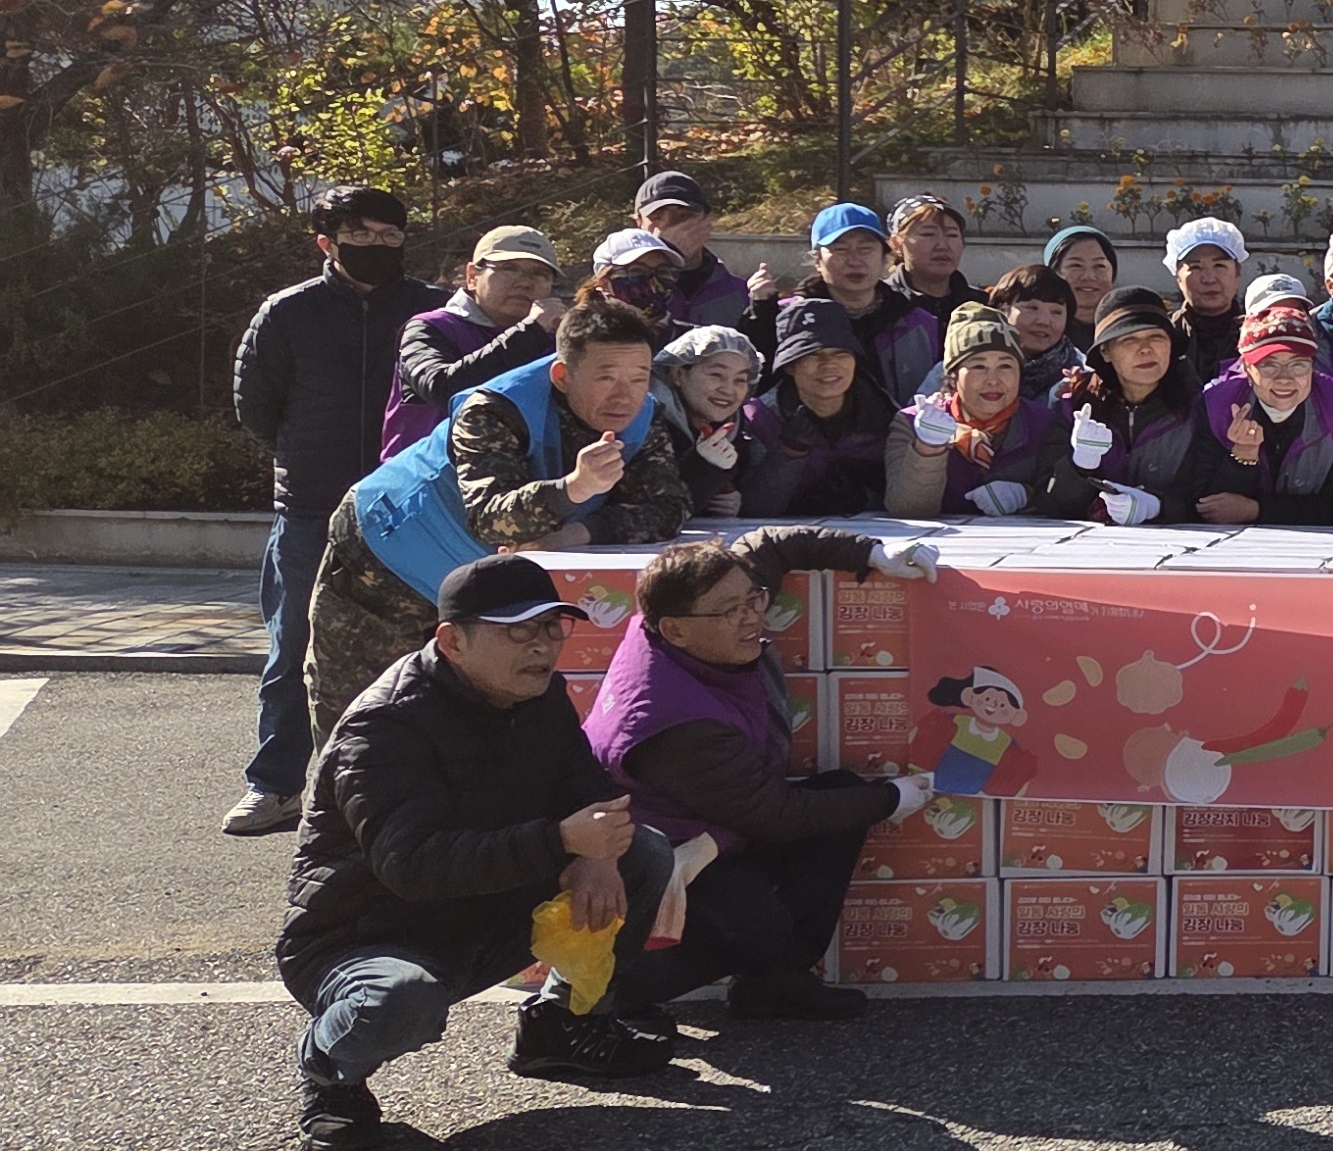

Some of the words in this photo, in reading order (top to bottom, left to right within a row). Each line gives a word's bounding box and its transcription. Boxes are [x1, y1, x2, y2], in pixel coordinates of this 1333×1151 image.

[838, 606, 869, 621] 김장
[872, 606, 904, 620] 나눔
[845, 717, 876, 732] 김장
[1012, 809, 1042, 824] 김장
[1045, 810, 1076, 826] 나눔
[1183, 812, 1239, 827] 김장김치
[1242, 813, 1270, 827] 나눔
[844, 922, 874, 938] 김장
[876, 922, 908, 938] 나눔
[1017, 921, 1047, 936] 김장
[1050, 921, 1080, 936] 나눔
[1182, 919, 1212, 933] 김장
[1215, 919, 1244, 933] 나눔
